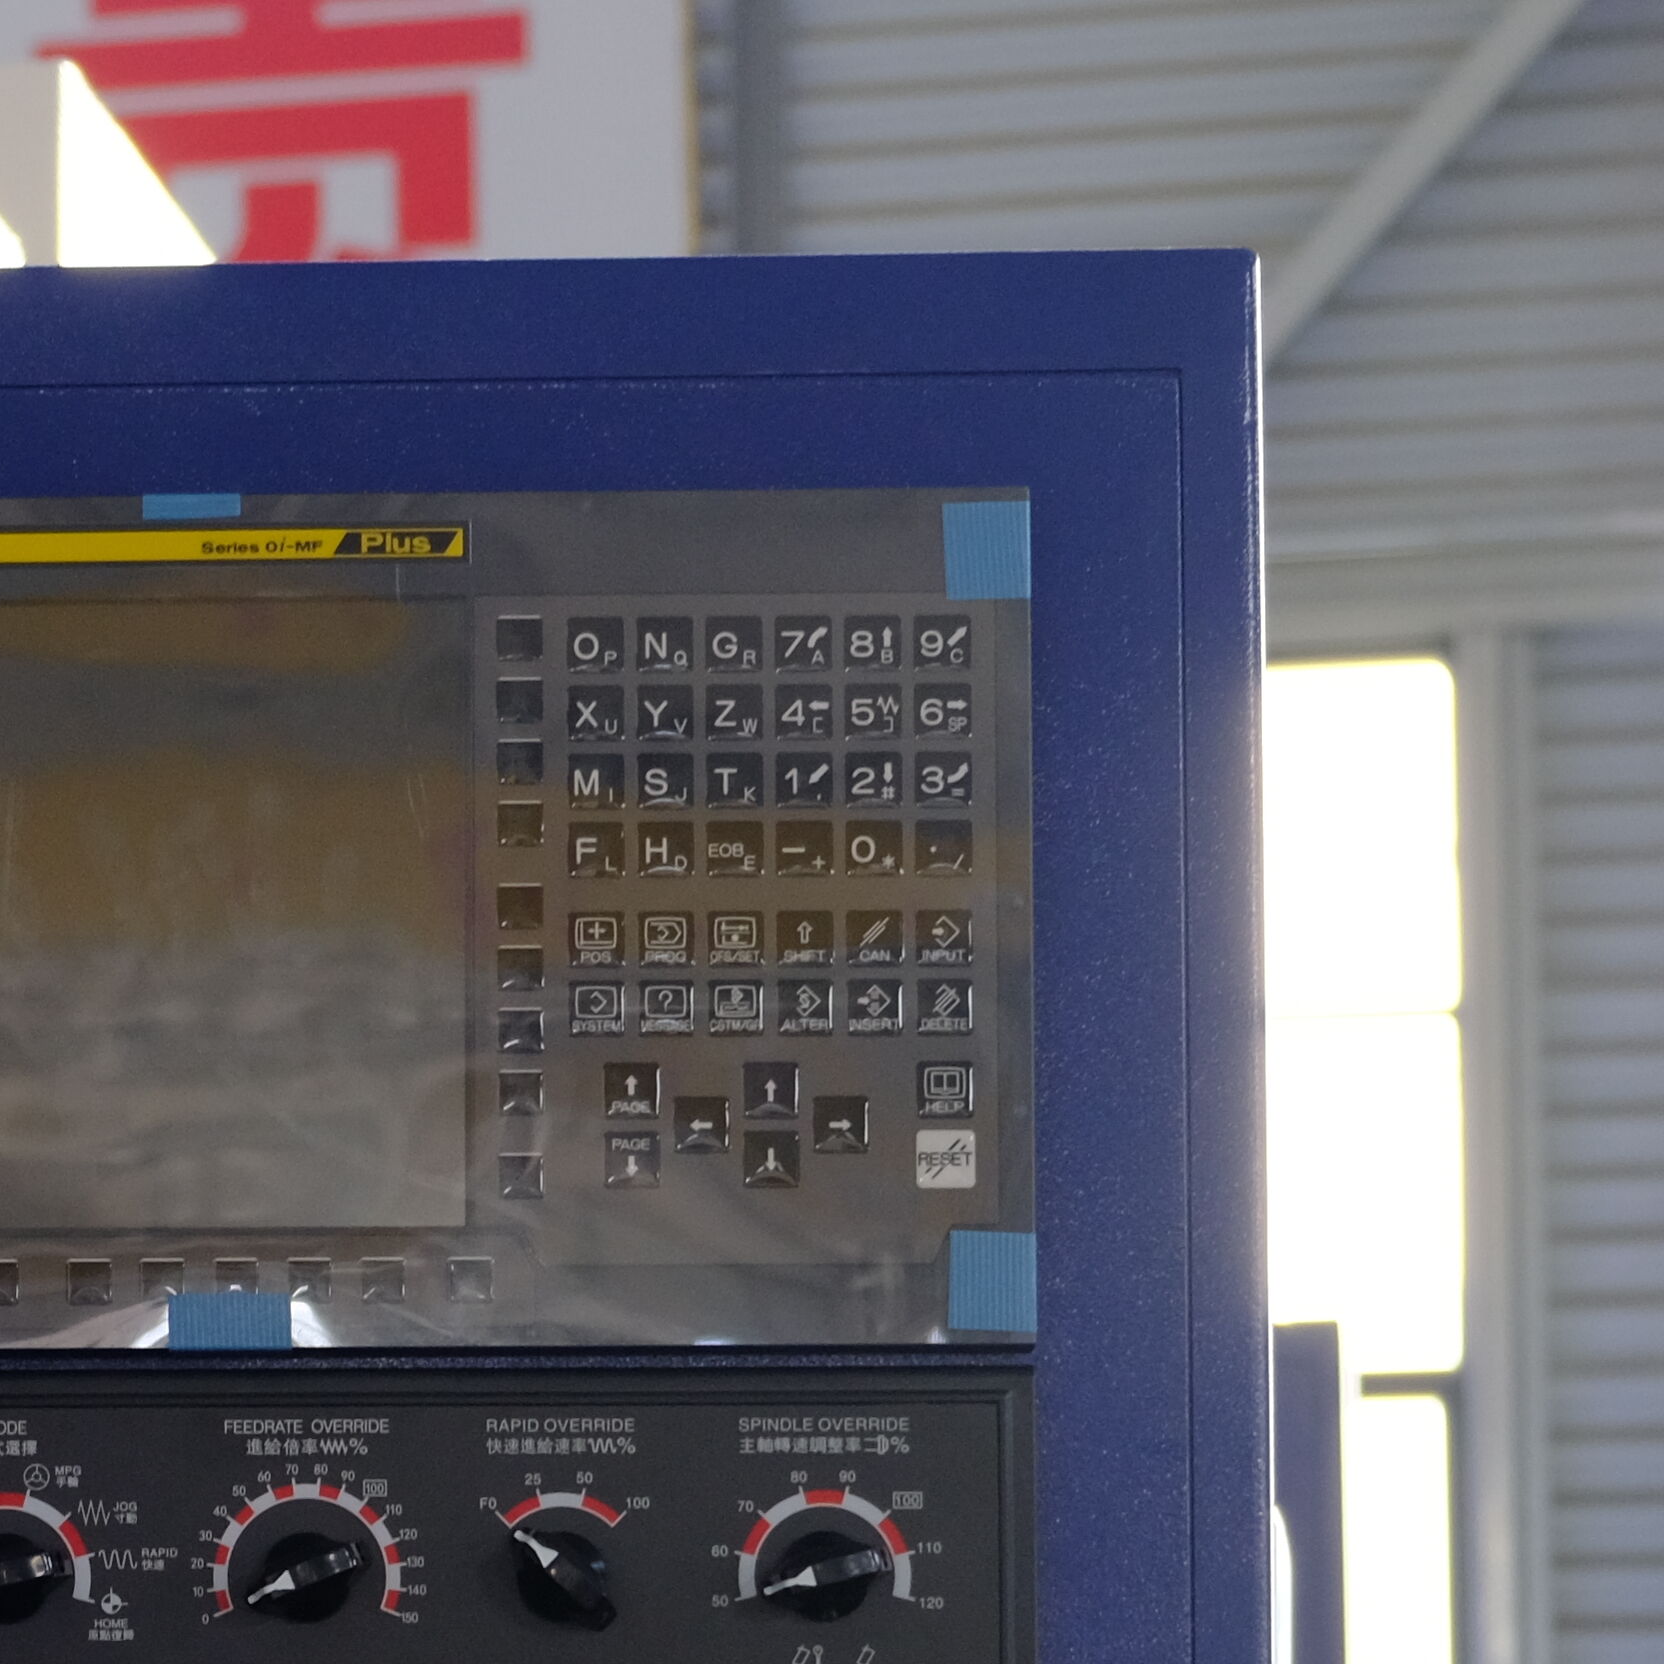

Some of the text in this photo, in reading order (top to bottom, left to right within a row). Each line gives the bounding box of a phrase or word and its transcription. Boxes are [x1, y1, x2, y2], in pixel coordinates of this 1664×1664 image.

[201, 541, 259, 556] Series
[360, 531, 432, 556] Plus
[644, 632, 668, 659] N
[712, 631, 739, 659] G
[780, 630, 805, 658] 7
[850, 630, 874, 658] 8
[920, 630, 943, 658] 9
[575, 700, 598, 728] X
[644, 700, 668, 727] Y
[714, 700, 737, 727] Z
[781, 699, 805, 726] 4
[851, 698, 875, 726] 5
[920, 698, 943, 726] 6
[573, 768, 600, 796] M
[644, 768, 669, 796] S
[714, 768, 738, 795] T
[784, 767, 798, 795] 1
[851, 767, 875, 795] 2
[921, 766, 944, 794] 3
[575, 837, 598, 864] F
[645, 837, 668, 864] H
[708, 843, 745, 858] EOB
[580, 951, 612, 963] POS
[645, 951, 687, 963] PROG
[784, 950, 826, 962] SHIFT
[859, 950, 891, 962] CAN
[922, 949, 966, 962] INPUT
[572, 1019, 622, 1032] SYSTEM
[782, 1018, 829, 1031] ALTER
[849, 1018, 899, 1031] INSERT
[921, 1018, 967, 1031] DELETE
[611, 1100, 650, 1114] PAGE
[924, 1100, 964, 1114] HELP
[611, 1136, 651, 1151] PAGE
[918, 1152, 974, 1167] RESET
[224, 1418, 390, 1435] FEEDRATE OVERRIDE
[486, 1417, 635, 1433] RAPID OVERRIDE
[738, 1416, 910, 1432] SPINDLE OVERRIDE
[55, 1465, 82, 1477] MPG
[285, 1463, 299, 1475] 70
[314, 1463, 328, 1475] 80
[258, 1471, 272, 1483] 60
[341, 1471, 355, 1482] 90
[524, 1473, 542, 1486] 25
[576, 1471, 594, 1484] 50
[790, 1470, 807, 1484] 80
[838, 1470, 856, 1483] 90
[232, 1485, 246, 1497] 50
[366, 1483, 385, 1496] 100
[113, 1501, 138, 1513] JOG
[626, 1496, 651, 1509] 100
[737, 1500, 754, 1513] 70
[894, 1495, 920, 1507] 100
[213, 1505, 227, 1517] 40
[386, 1504, 403, 1516] 110
[199, 1530, 213, 1542] 30
[400, 1529, 418, 1541] 120
[141, 1547, 178, 1560] RAPID
[711, 1545, 728, 1558] 60
[916, 1541, 942, 1554] 110
[190, 1558, 205, 1569] 20
[407, 1556, 425, 1568] 130
[191, 1586, 204, 1597] 10
[408, 1585, 427, 1597] 140
[711, 1595, 729, 1607] 50
[919, 1598, 945, 1610] 120
[94, 1619, 128, 1630] HOME
[201, 1614, 210, 1625] 0
[402, 1613, 419, 1624] 150
